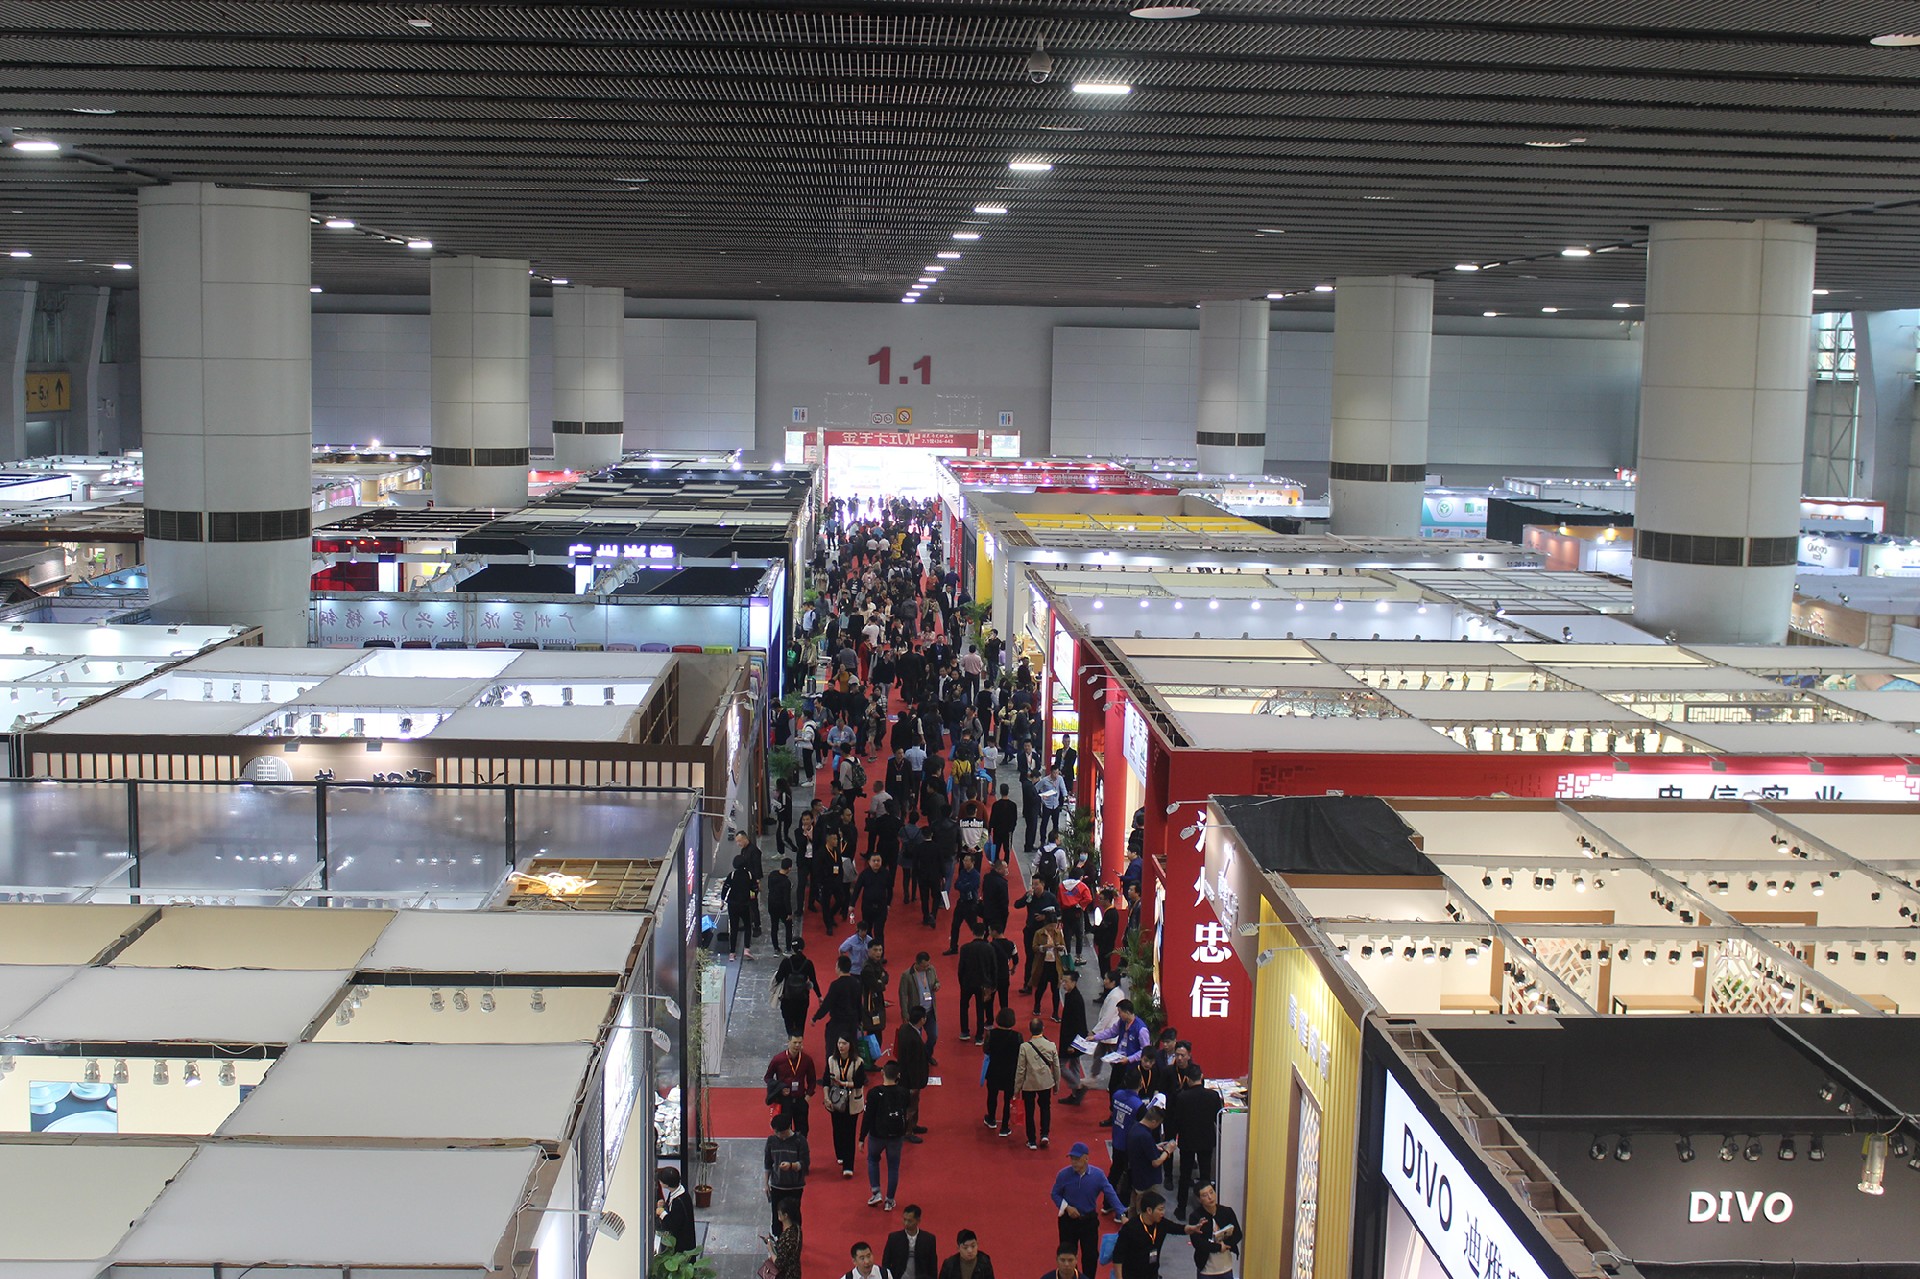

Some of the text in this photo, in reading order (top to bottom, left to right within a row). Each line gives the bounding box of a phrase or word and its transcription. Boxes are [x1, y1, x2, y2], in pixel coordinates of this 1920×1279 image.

[868, 346, 931, 385] 1.1
[1402, 1122, 1453, 1231] DIVO
[1689, 1190, 1794, 1224] DIVO
